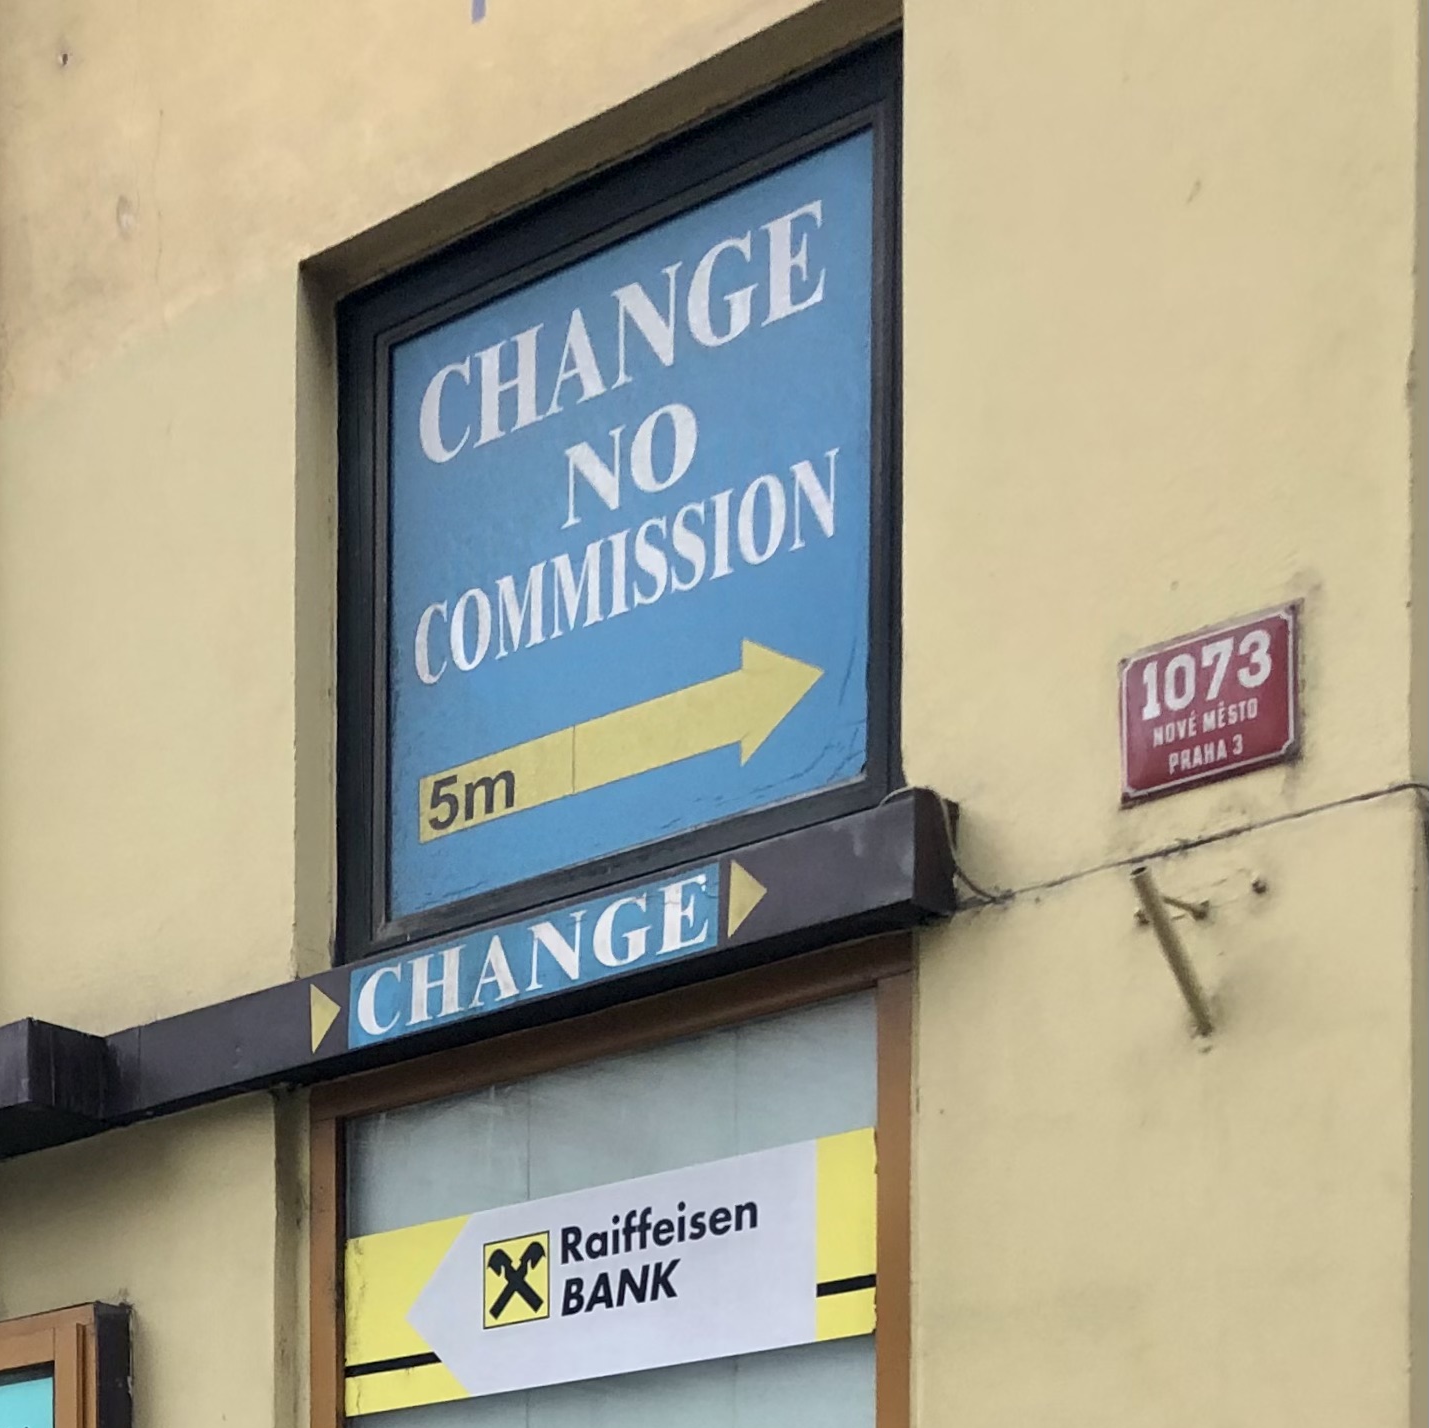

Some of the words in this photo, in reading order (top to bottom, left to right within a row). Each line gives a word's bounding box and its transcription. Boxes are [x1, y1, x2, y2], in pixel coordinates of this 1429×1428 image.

[419, 200, 825, 465] CHANGE
[562, 402, 698, 530] NO
[414, 447, 839, 685] COMMISSION
[1142, 629, 1272, 721] 1073
[1153, 711, 1197, 747] NOVÉ
[1168, 739, 1227, 775] PRAHA
[1232, 734, 1243, 756] 3
[428, 768, 516, 832] 5m
[357, 873, 710, 1036] CHANGE
[560, 1200, 758, 1264] Raiffeisen
[561, 1259, 681, 1317] BANK
